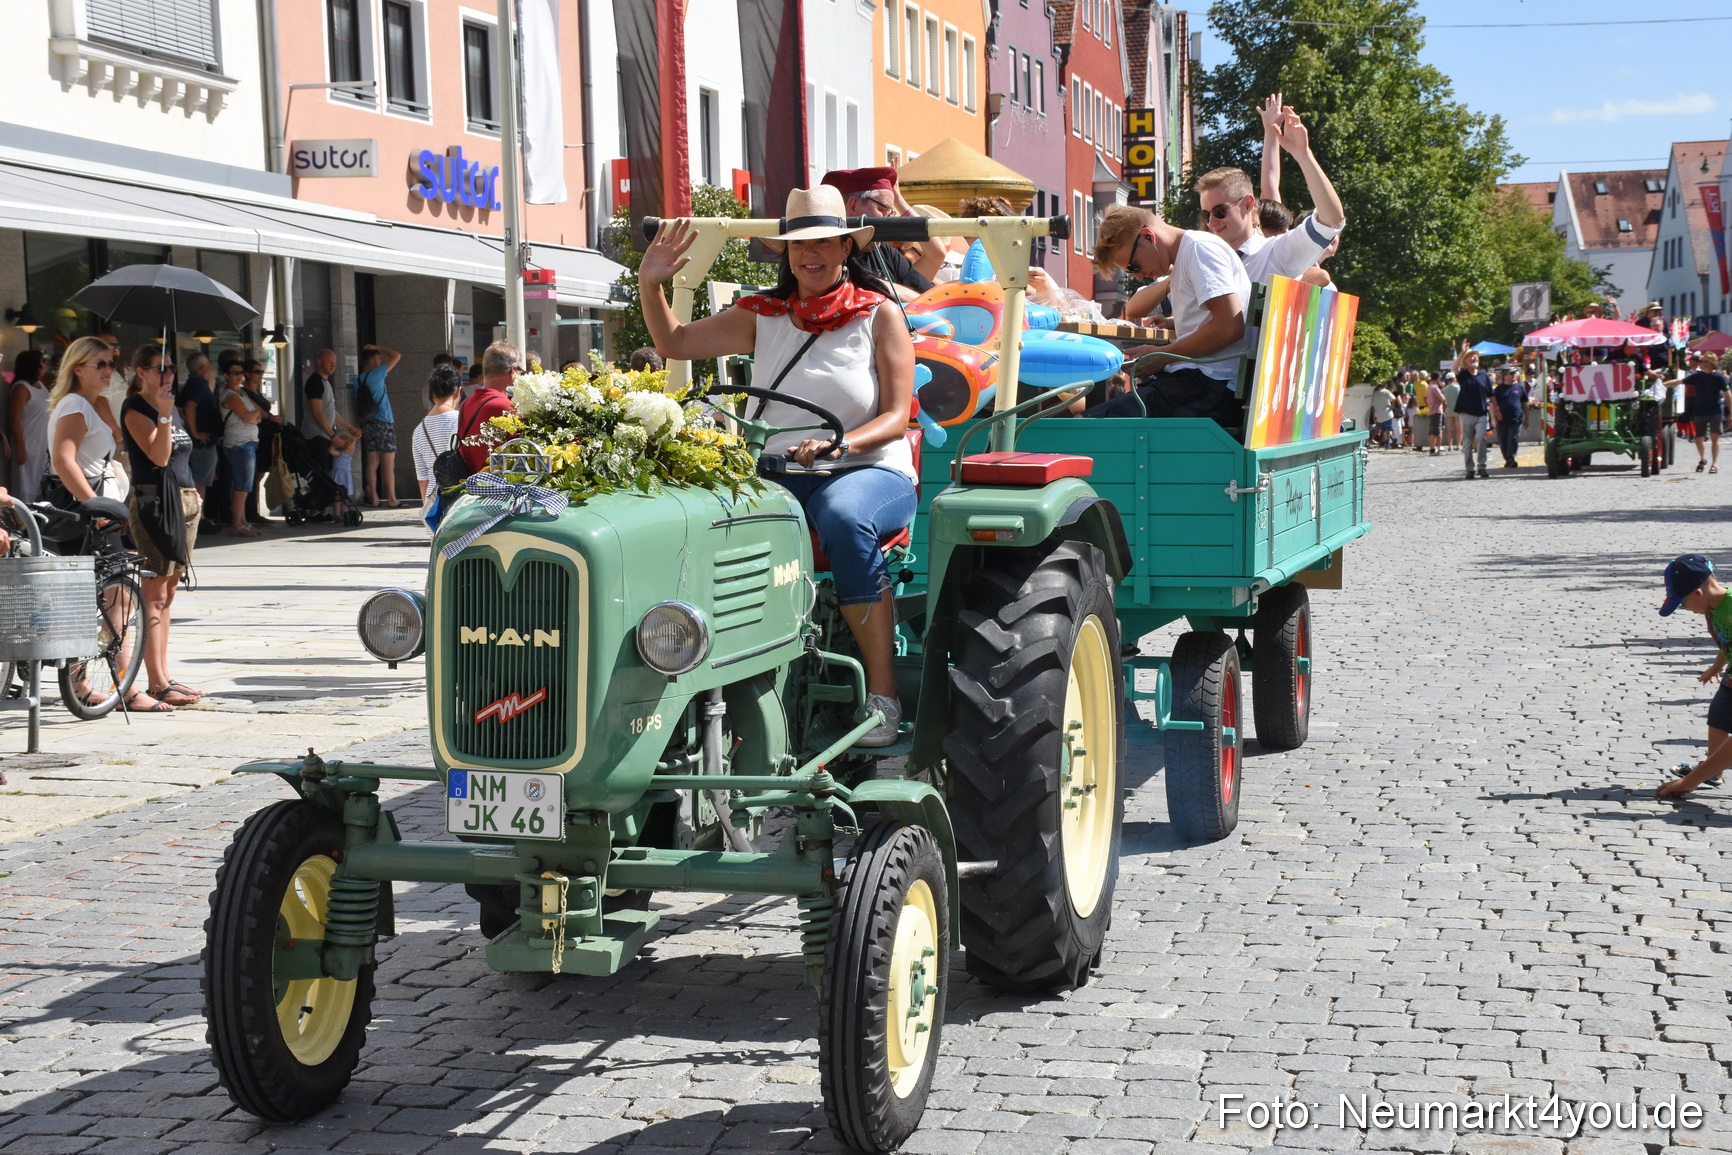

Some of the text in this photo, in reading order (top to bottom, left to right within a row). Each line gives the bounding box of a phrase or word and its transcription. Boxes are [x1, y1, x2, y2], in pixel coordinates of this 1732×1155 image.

[294, 145, 370, 170] sutor.
[1128, 112, 1155, 213] HOT
[418, 145, 502, 211] sutor.
[1565, 363, 1633, 401] KAB
[629, 713, 662, 735] 18 PS
[455, 774, 507, 802] D NM
[463, 804, 545, 834] JK 46
